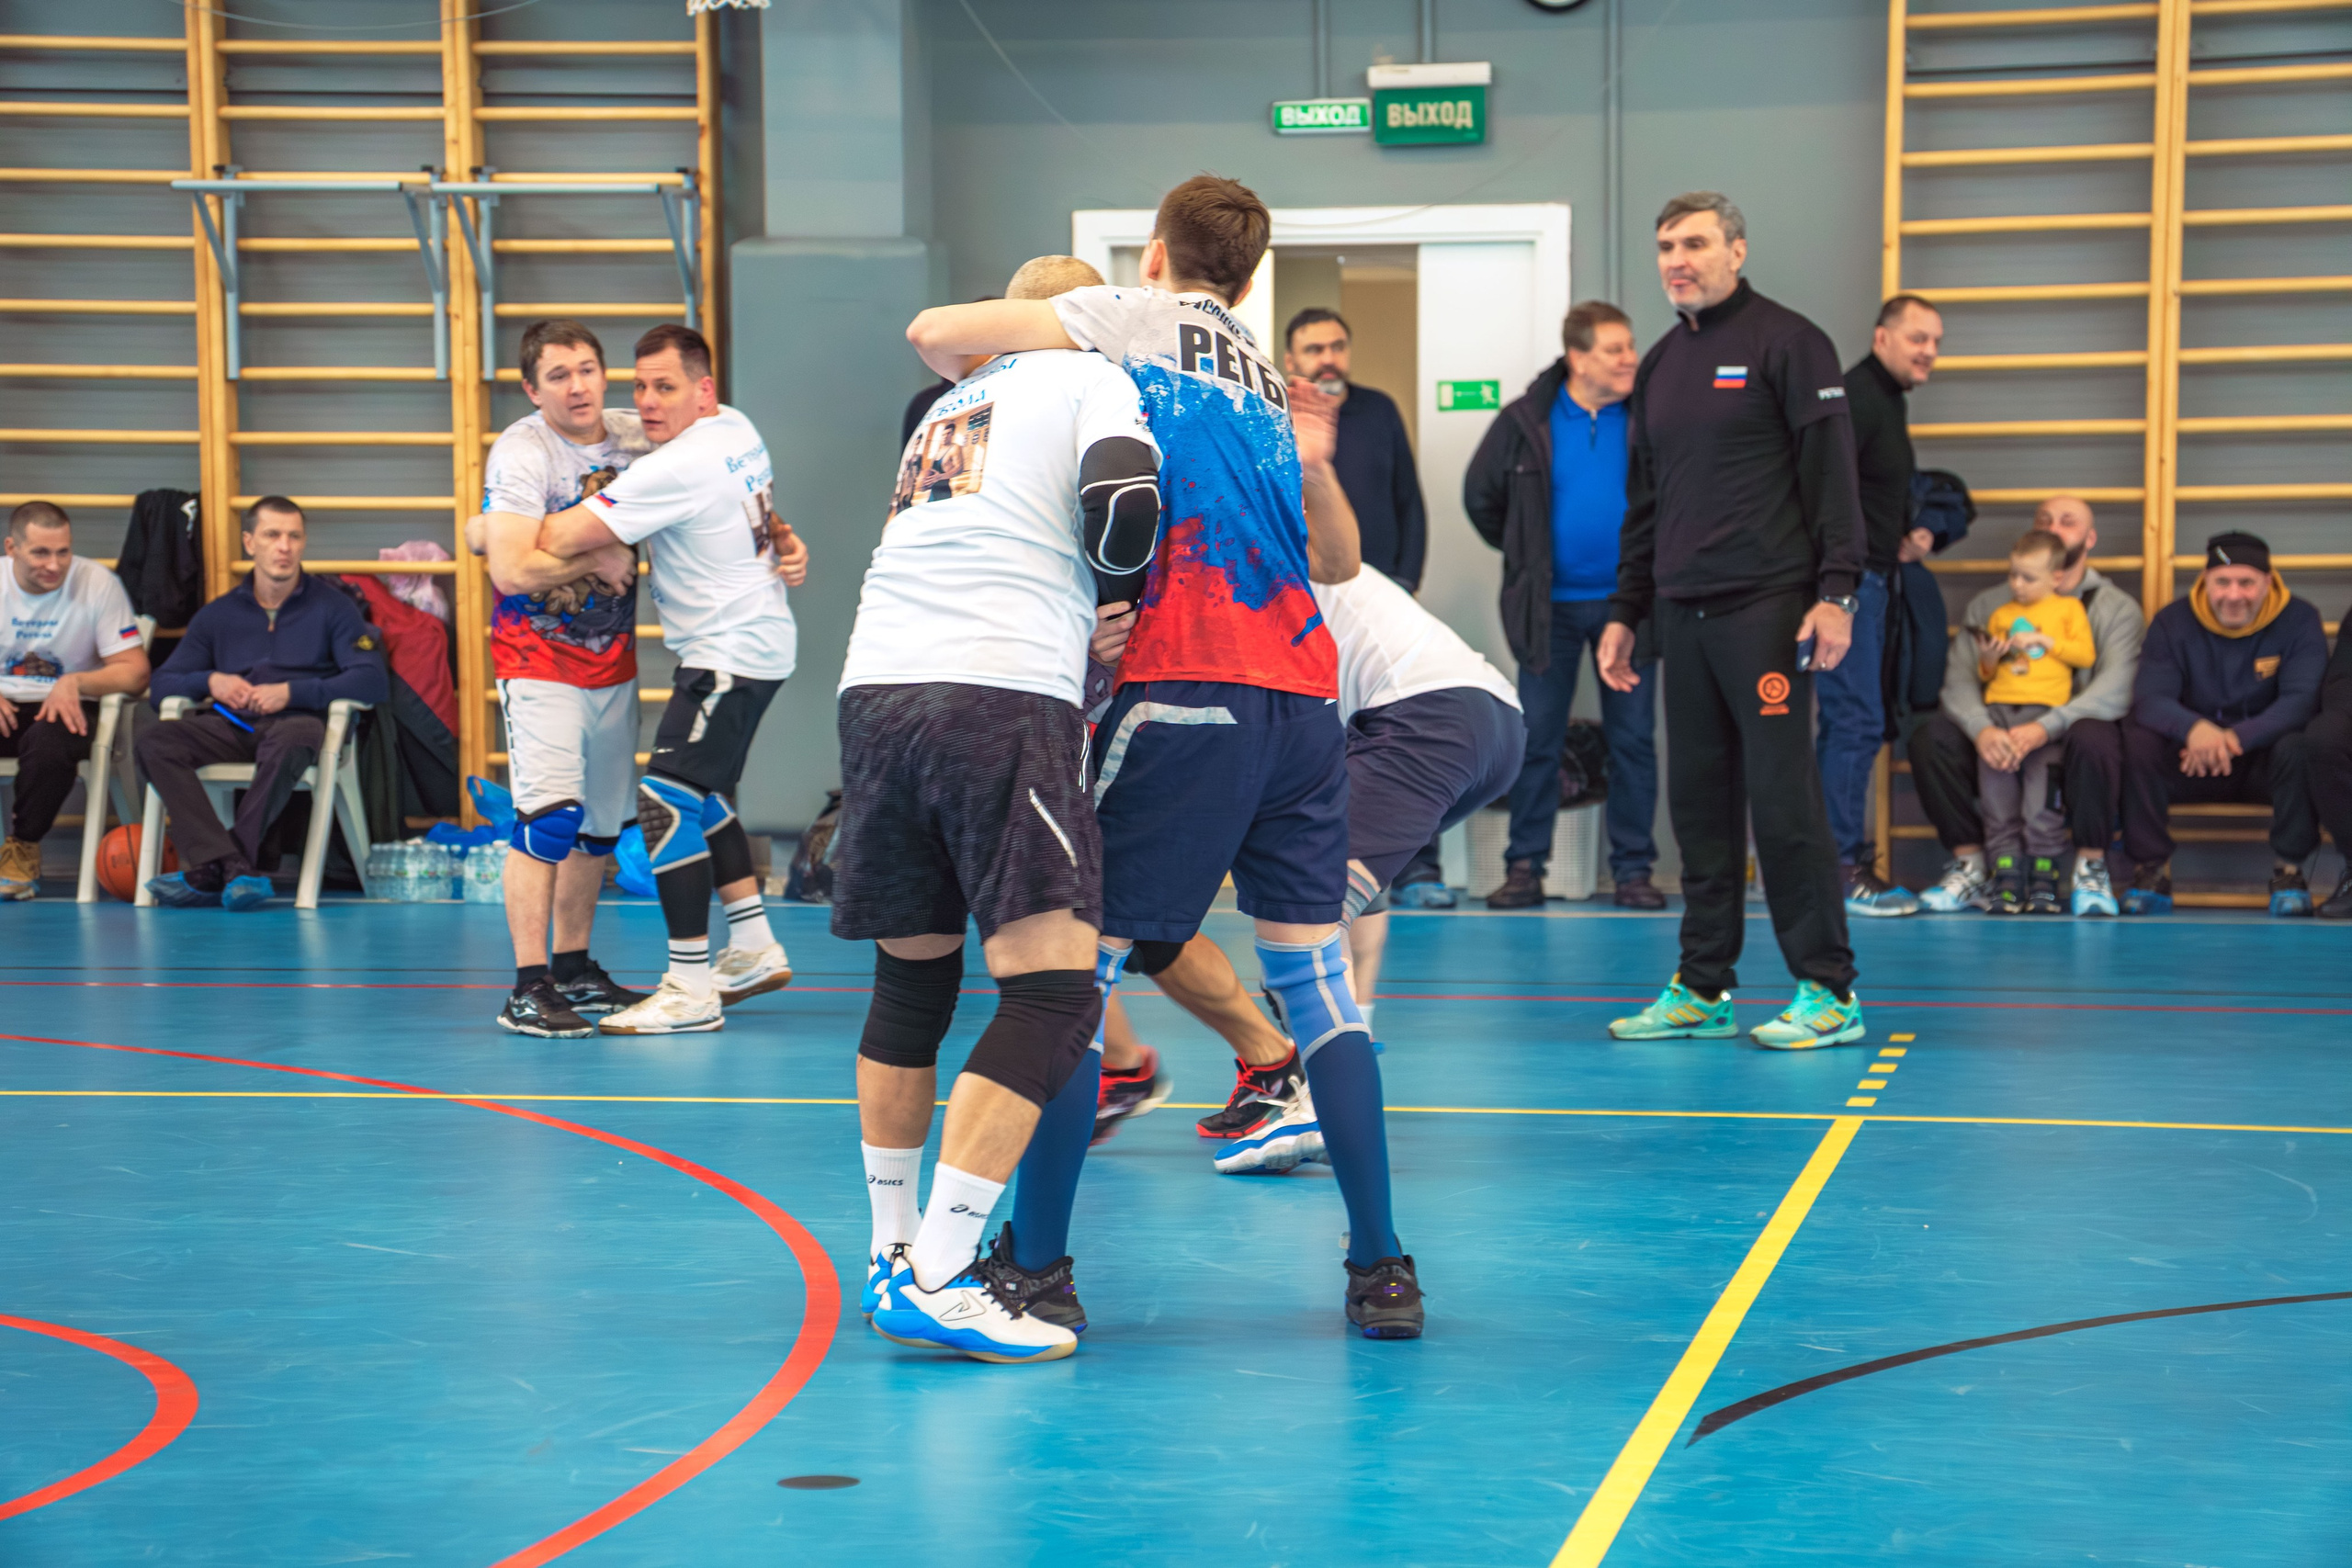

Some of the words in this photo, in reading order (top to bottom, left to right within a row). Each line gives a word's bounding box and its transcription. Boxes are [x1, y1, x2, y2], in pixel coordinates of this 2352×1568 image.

[1280, 105, 1362, 127] ВЫХОД
[1387, 100, 1474, 130] ВЫХОД
[1179, 323, 1287, 411] РЕГБ
